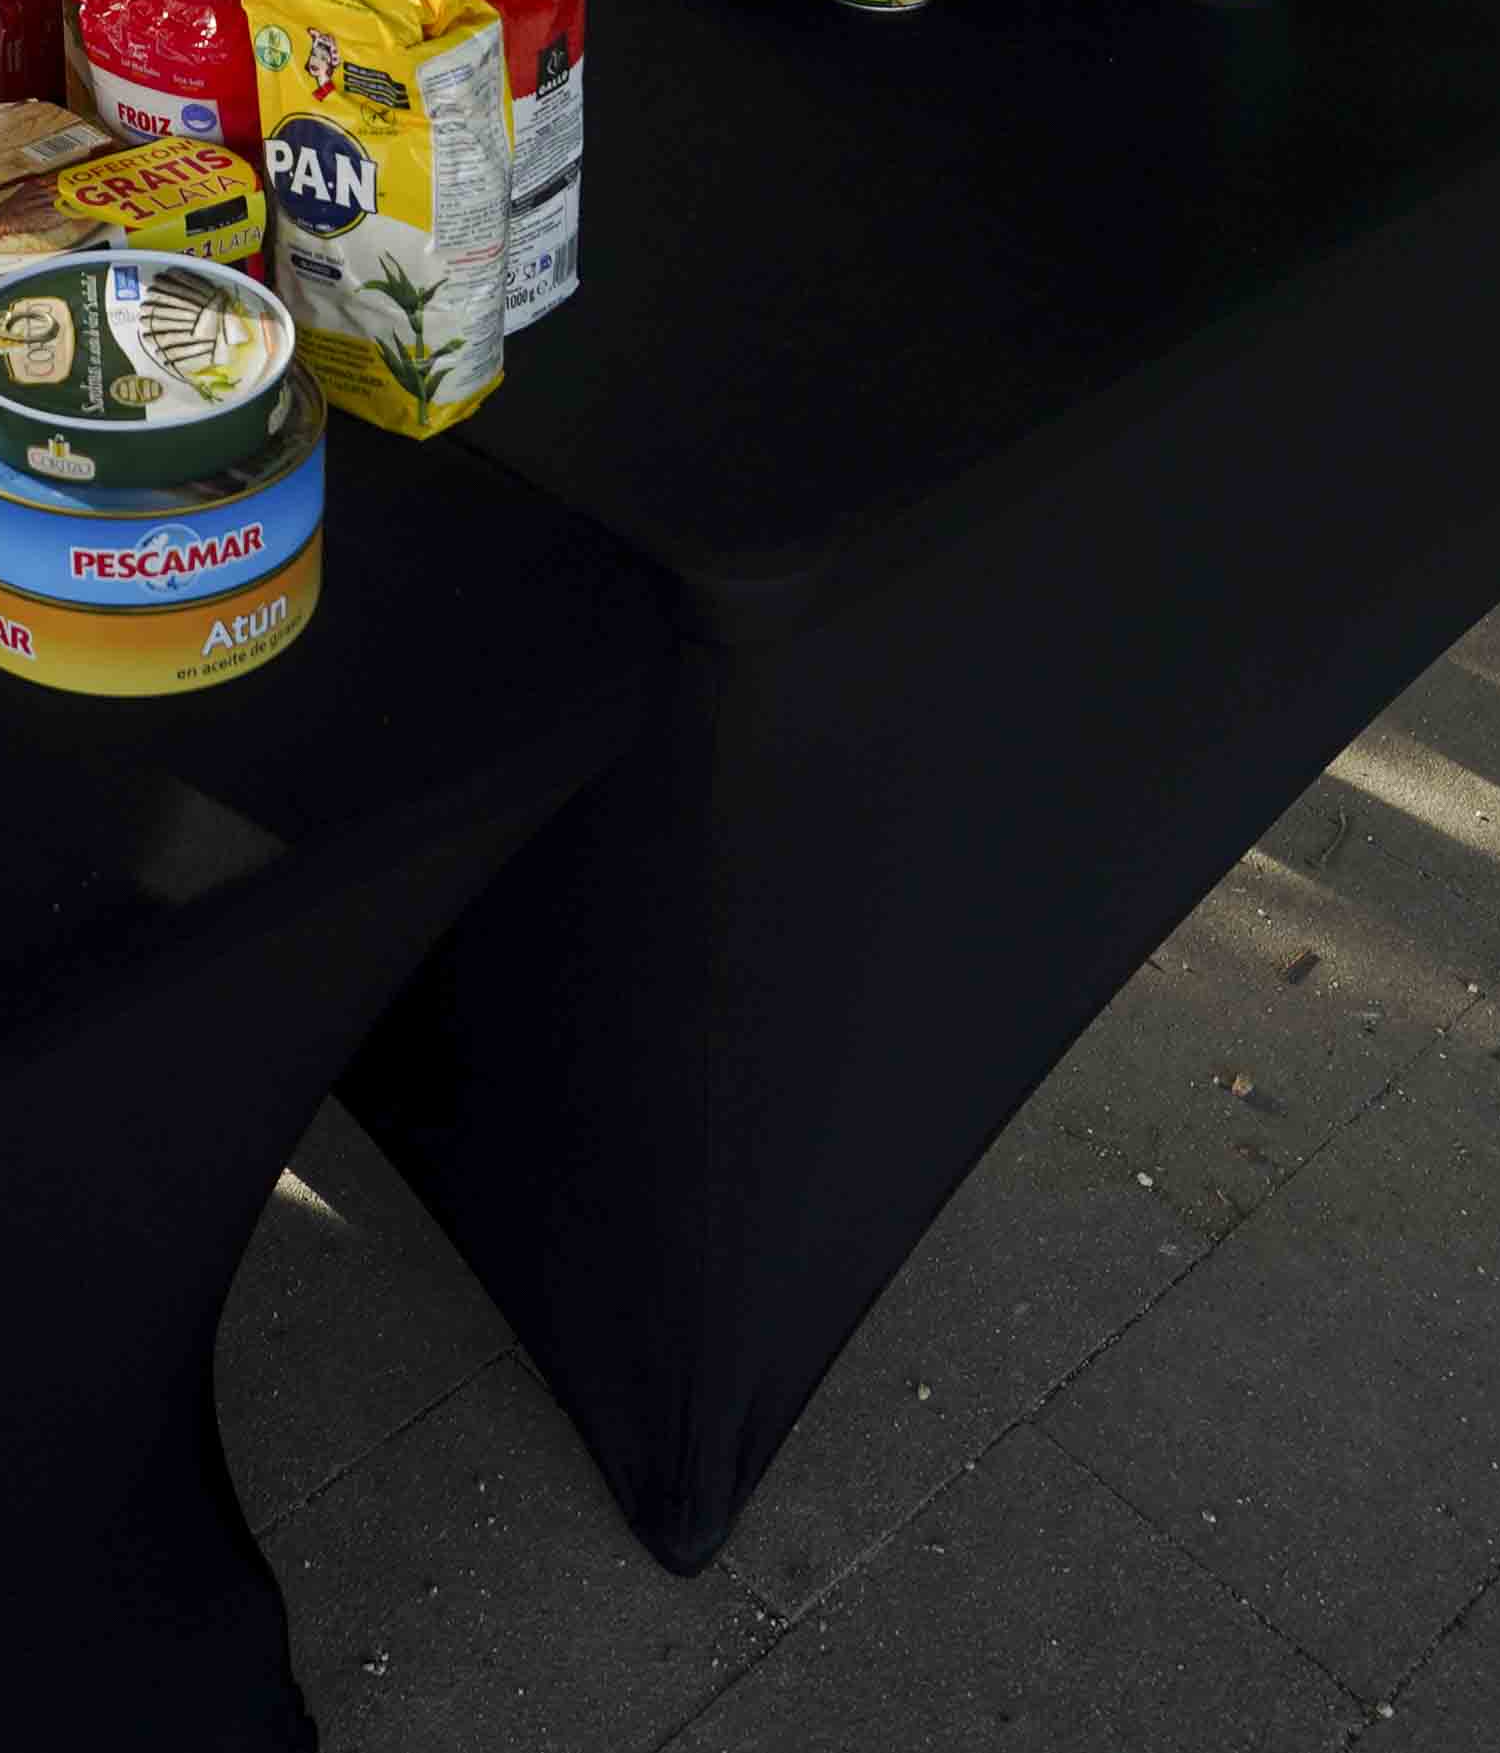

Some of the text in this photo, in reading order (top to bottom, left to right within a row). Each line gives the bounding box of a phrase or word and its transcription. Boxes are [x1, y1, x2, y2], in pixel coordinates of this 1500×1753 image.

[117, 101, 173, 137] FROIZ
[75, 148, 234, 206] GRATIS
[120, 174, 250, 221] 1 LATA
[72, 524, 264, 580] PESCAMAR
[201, 594, 288, 657] Atún
[177, 666, 198, 680] en
[202, 650, 248, 674] aceite
[250, 641, 267, 657] de
